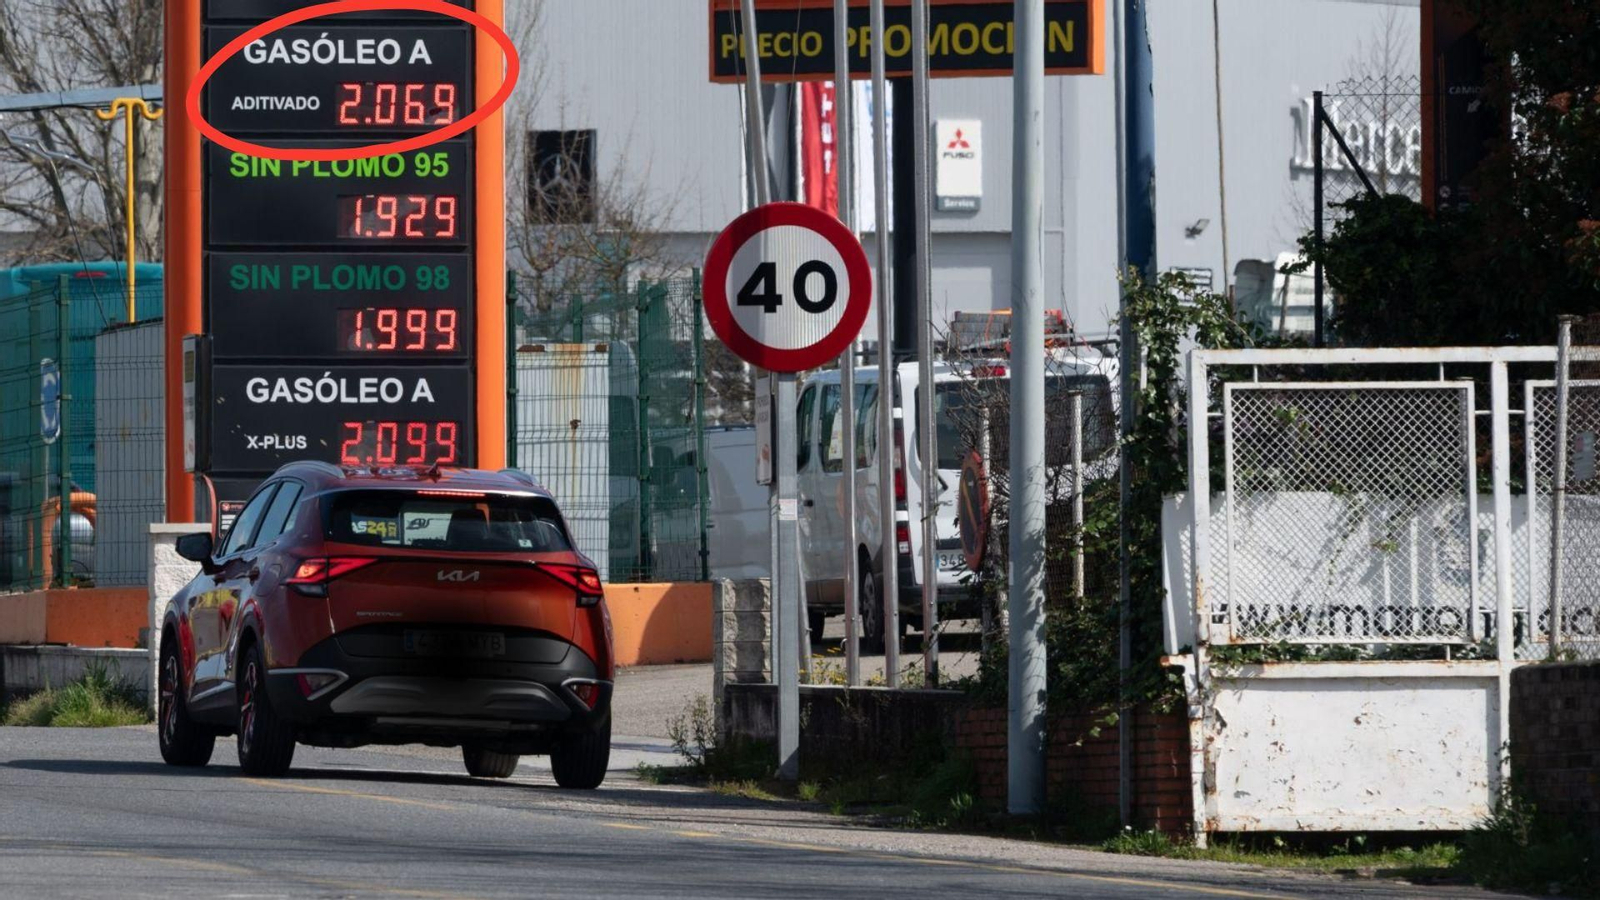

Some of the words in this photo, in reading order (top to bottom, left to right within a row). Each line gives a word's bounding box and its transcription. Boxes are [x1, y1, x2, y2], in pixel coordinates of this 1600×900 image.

[244, 33, 401, 64] GASÓLEO
[409, 39, 432, 64] A
[721, 31, 822, 58] PECIO
[846, 20, 1074, 57] PROMOCIN
[231, 96, 320, 111] ADITIVADO
[340, 83, 455, 125] 2.069
[230, 153, 281, 177] SIN
[291, 154, 405, 177] PLOMO
[414, 152, 449, 177] 95
[354, 196, 455, 237] 1.929
[230, 264, 281, 291] SIN
[291, 264, 406, 291] PLOMO
[416, 264, 450, 291] 98
[736, 259, 838, 314] 40
[354, 309, 456, 350] 1.999
[246, 372, 403, 403] GASÓLEO
[411, 378, 434, 403] A
[246, 434, 307, 450] X-PLUS
[341, 422, 456, 464] 2.099
